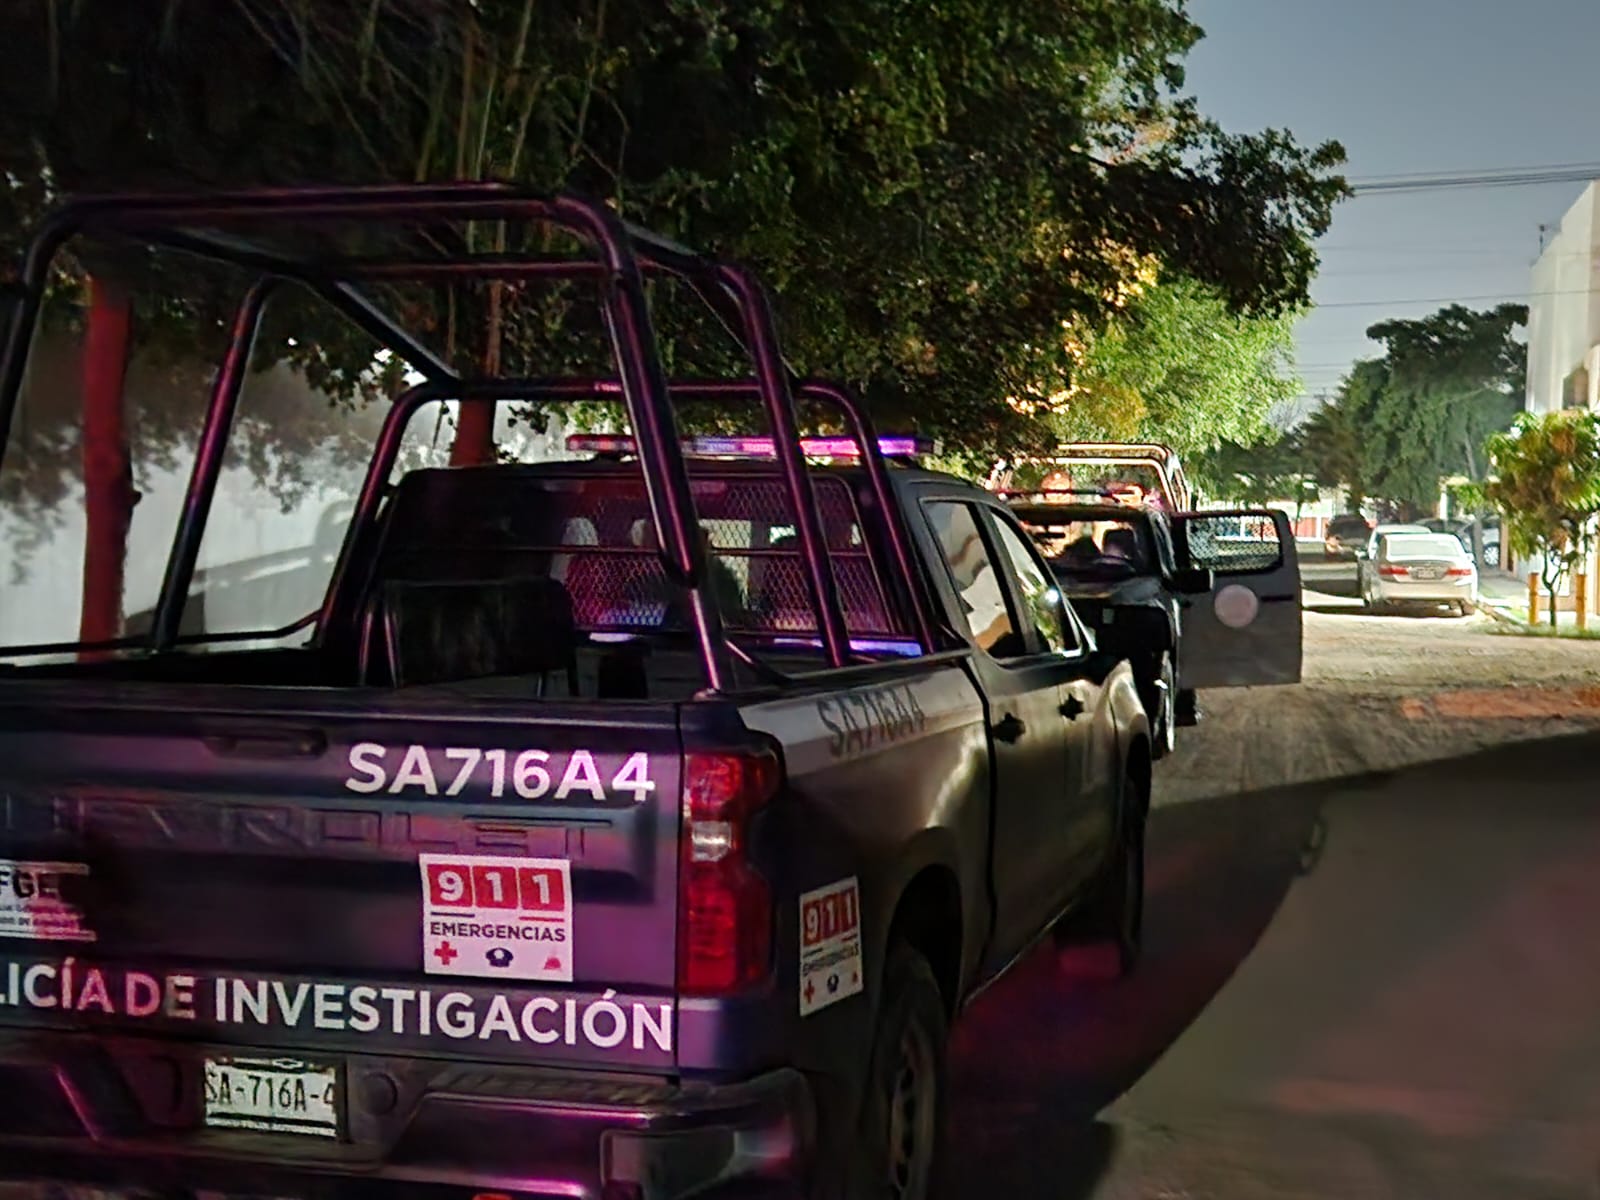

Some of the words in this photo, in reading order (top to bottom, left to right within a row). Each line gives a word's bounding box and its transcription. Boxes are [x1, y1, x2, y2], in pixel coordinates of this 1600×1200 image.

[345, 742, 655, 801] SA716A4
[437, 870, 551, 904] 911
[430, 922, 566, 942] EMERGENCIAS
[0, 956, 115, 1014] ICÍA
[125, 972, 197, 1020] DE
[214, 977, 672, 1052] INVESTIGACIÓN
